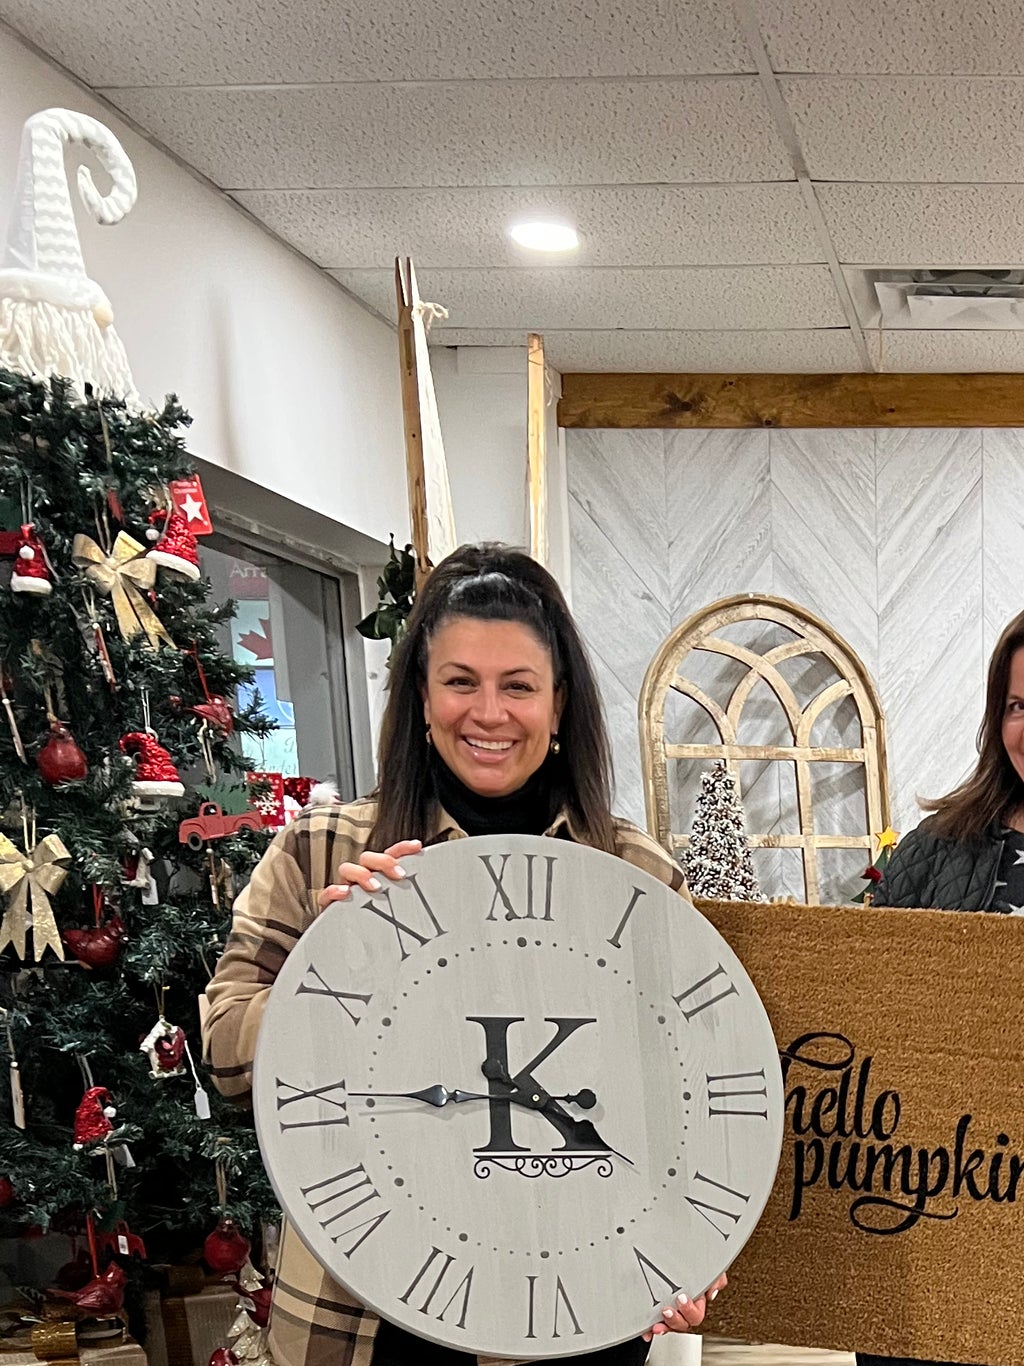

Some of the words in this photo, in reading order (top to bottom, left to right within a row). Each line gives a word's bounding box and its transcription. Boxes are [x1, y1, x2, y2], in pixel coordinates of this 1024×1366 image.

[361, 873, 448, 961] XI
[478, 853, 558, 922] XII
[606, 885, 647, 949] I
[295, 963, 373, 1026] X
[672, 962, 740, 1023] II
[465, 1016, 598, 1152] K
[705, 1068, 768, 1121] III
[779, 1032, 901, 1141] hello
